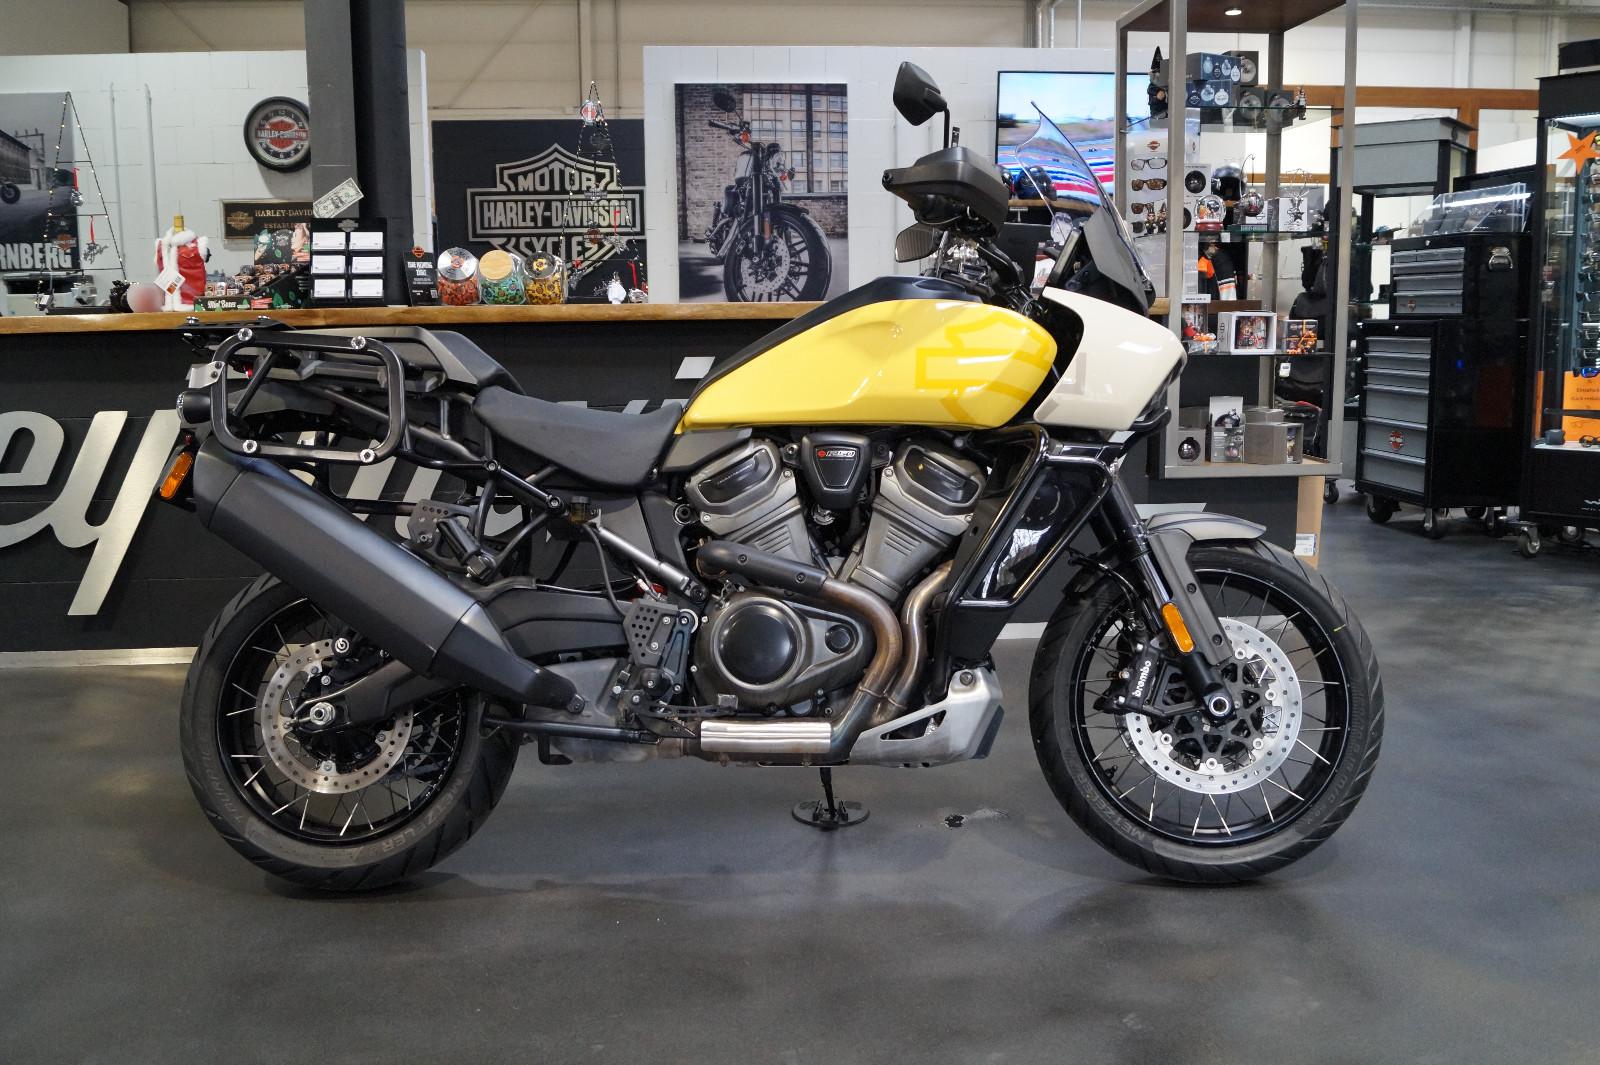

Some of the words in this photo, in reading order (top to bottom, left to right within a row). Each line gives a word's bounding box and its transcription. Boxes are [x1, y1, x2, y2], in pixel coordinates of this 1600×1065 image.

[517, 161, 597, 192] MOTOR
[483, 199, 634, 229] HARLEY-DAVIDSON
[1131, 660, 1152, 698] brembo
